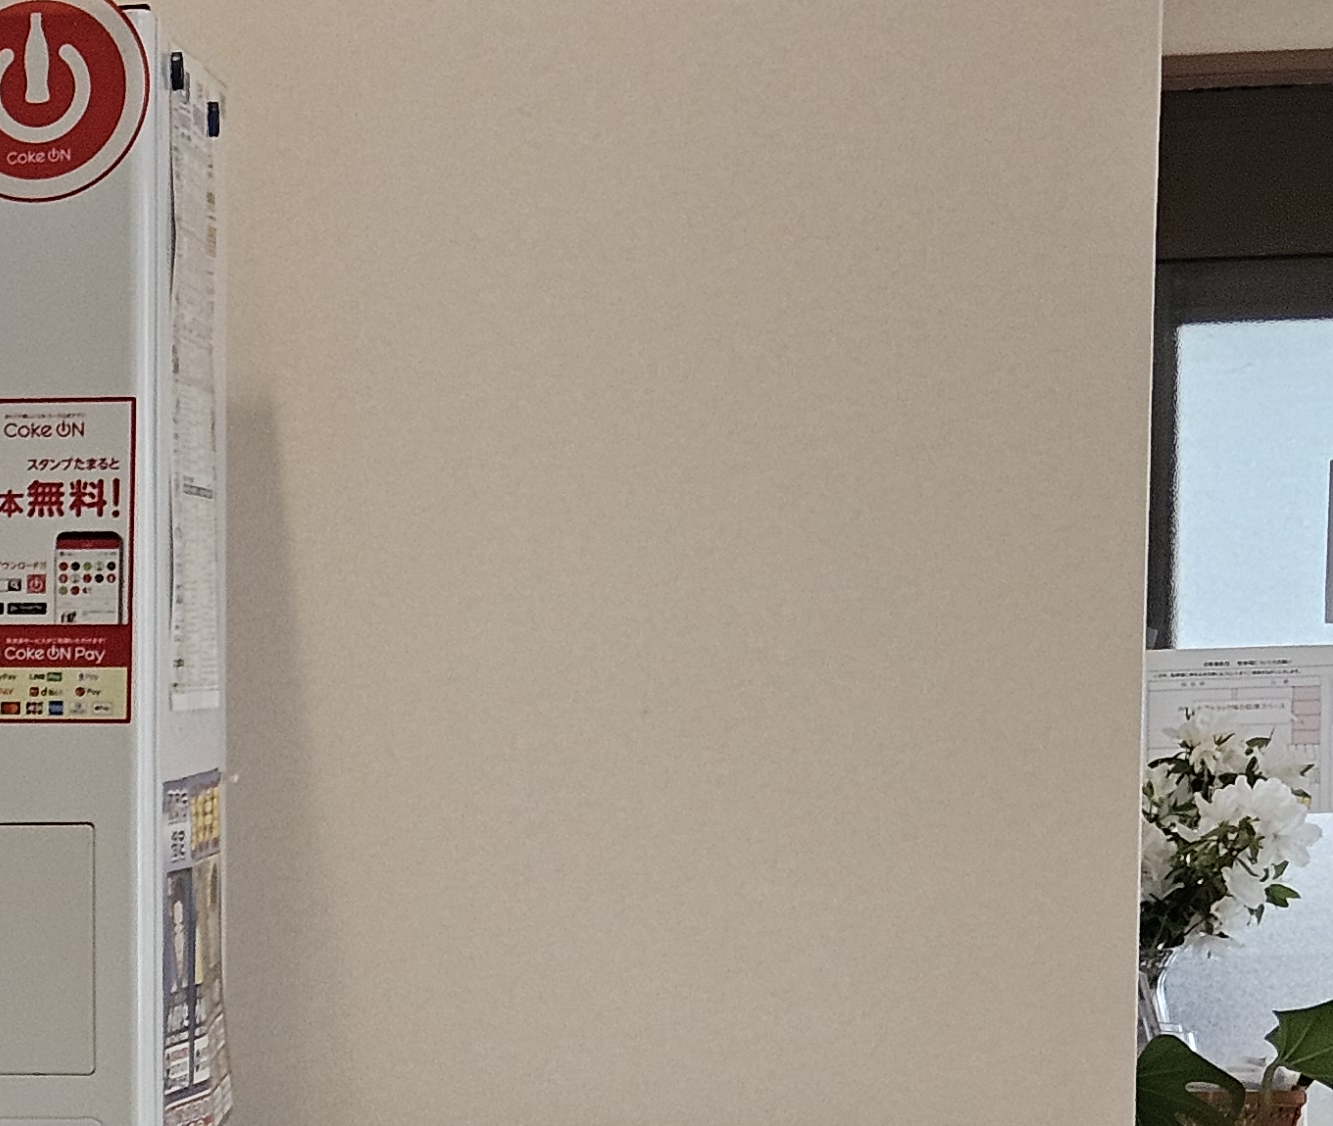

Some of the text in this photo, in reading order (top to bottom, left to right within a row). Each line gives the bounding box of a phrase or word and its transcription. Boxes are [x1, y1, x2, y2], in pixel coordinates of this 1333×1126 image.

[6, 150, 45, 165] Coke
[4, 420, 85, 438] Coke ON
[27, 457, 120, 471] スタンプたまると
[4, 647, 45, 661] Coke
[75, 647, 106, 664] Pay
